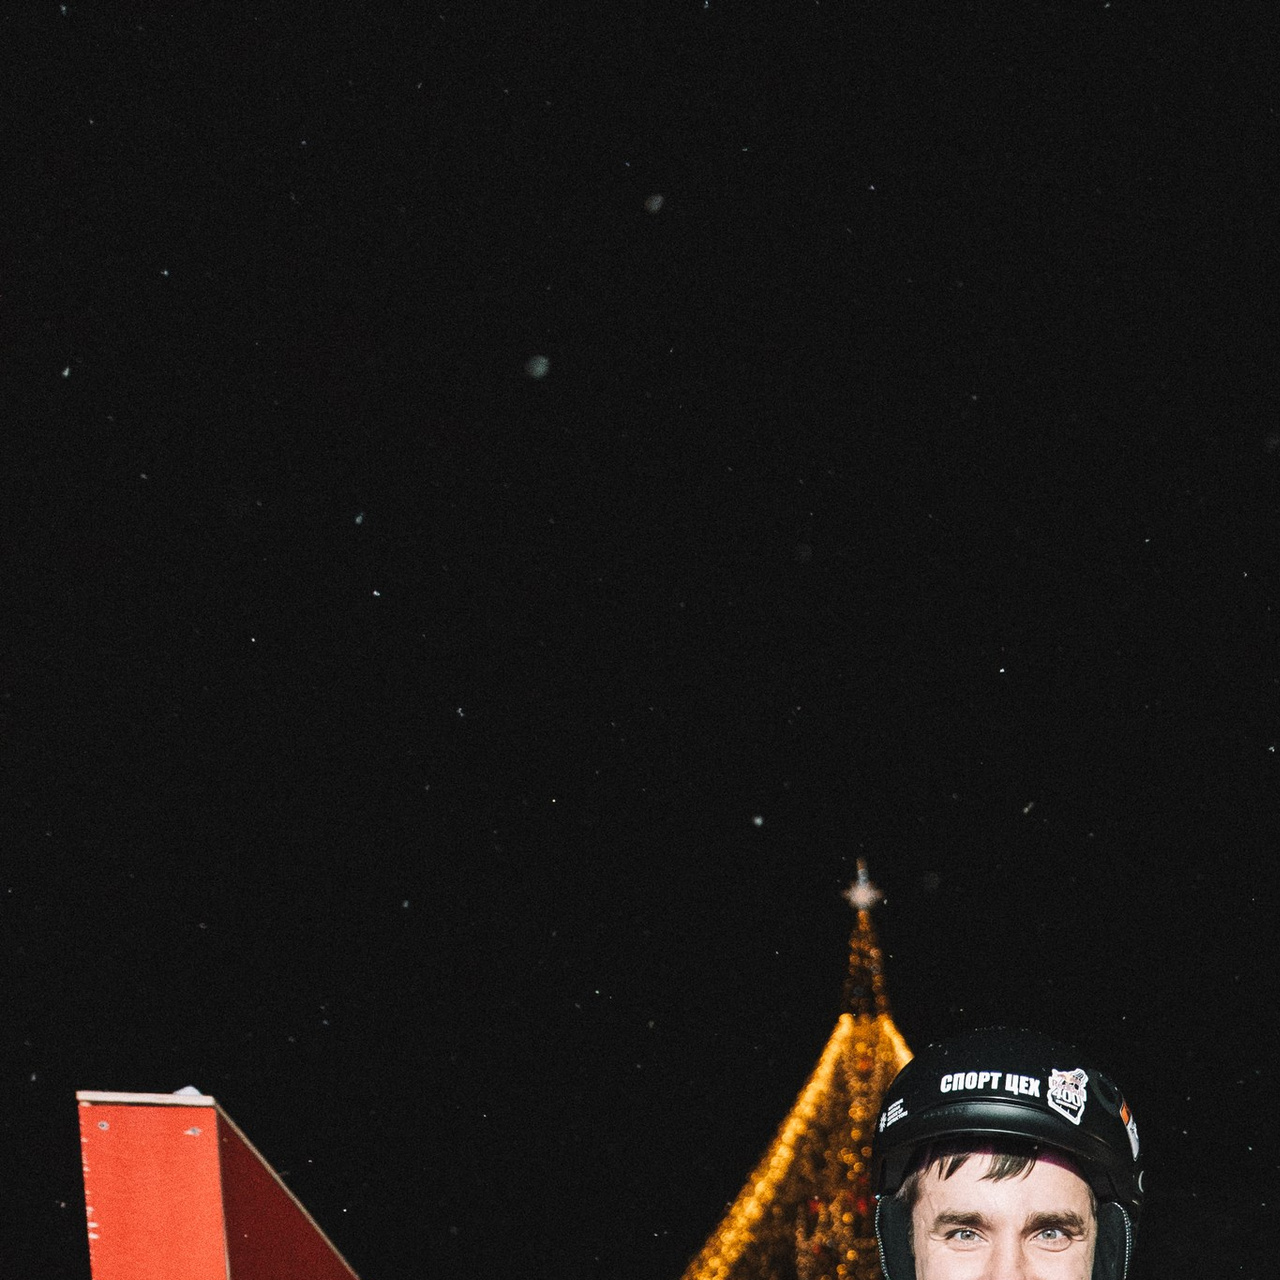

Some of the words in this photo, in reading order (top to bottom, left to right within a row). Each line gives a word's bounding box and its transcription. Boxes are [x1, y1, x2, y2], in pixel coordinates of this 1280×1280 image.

[940, 1071, 1002, 1093] СПОРТ
[1004, 1073, 1040, 1098] ЦЕХ
[1052, 1088, 1081, 1107] 400
